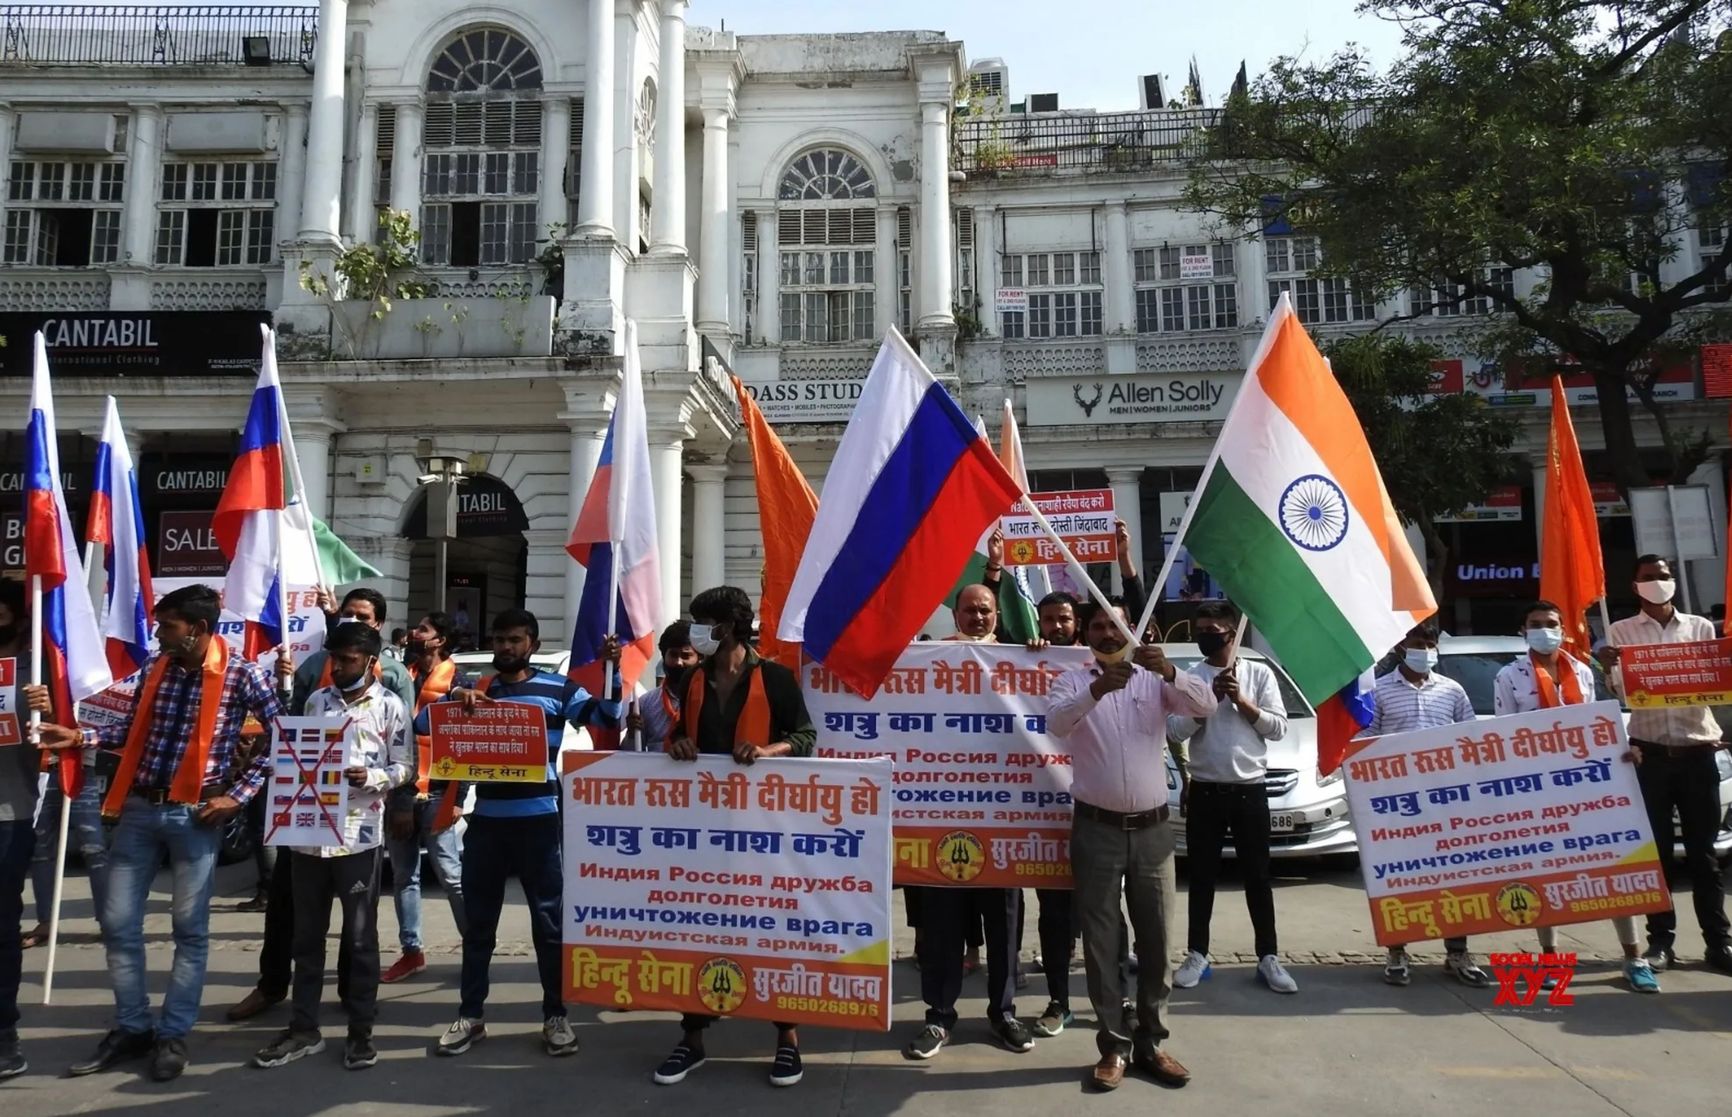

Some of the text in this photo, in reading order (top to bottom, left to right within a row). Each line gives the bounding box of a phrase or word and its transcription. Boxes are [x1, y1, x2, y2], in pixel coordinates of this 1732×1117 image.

[42, 319, 158, 347] CANTABIL
[49, 355, 160, 365] nternational Clothing
[746, 383, 862, 401] DASS STUD
[1108, 380, 1224, 405] Allen Solly
[157, 471, 227, 490] CANTABIL
[457, 493, 506, 512] TABIL
[165, 528, 220, 552] SALE
[1010, 522, 1029, 534] भारत
[1075, 537, 1111, 555] सेना
[1458, 564, 1524, 581] Union
[932, 660, 990, 695] मैत्री
[990, 660, 1066, 696] दीर्घा
[447, 708, 462, 718] 1971
[824, 712, 880, 740] शत्रु
[888, 712, 937, 733] का
[944, 712, 1017, 734] नाश
[906, 749, 997, 764] Россия
[1005, 754, 1073, 768] друж
[1349, 715, 1619, 783] भारत रूस मैत्री दीर्घायु हो
[468, 764, 528, 779] हिन्दू सेना
[572, 771, 881, 825] भारत रूस मैत्री दीर्घायु हो
[892, 789, 1071, 807] ожение вра
[1370, 757, 1613, 816] शत्रु का नाश करों
[892, 809, 1071, 822] стская армия
[1371, 794, 1631, 842] Индия Россия дружба
[586, 825, 866, 858] शत्रु का नाश करों
[990, 832, 1058, 869] सुरजीत
[1434, 822, 1571, 851] долголетия
[1373, 827, 1641, 879] уничтожение врага
[580, 863, 873, 893] Индия Россия дружба
[1016, 863, 1072, 875] 965026
[1386, 851, 1622, 889] Индуистская армия.
[648, 888, 799, 910] долголетия
[1542, 874, 1609, 910] सुरजीत
[1611, 869, 1660, 895] यादव
[1571, 893, 1662, 912] 9650268976
[574, 904, 873, 937] уничтожение врага
[1380, 897, 1442, 937] हिन्दू
[1439, 888, 1493, 925] सेना
[584, 925, 846, 955] Индуистская армия.
[571, 947, 632, 1004] हिन्दू
[638, 949, 694, 996] सेना
[753, 963, 824, 1002] सुरजीत
[828, 974, 882, 1001] यादव
[777, 997, 879, 1017] 9650268976
